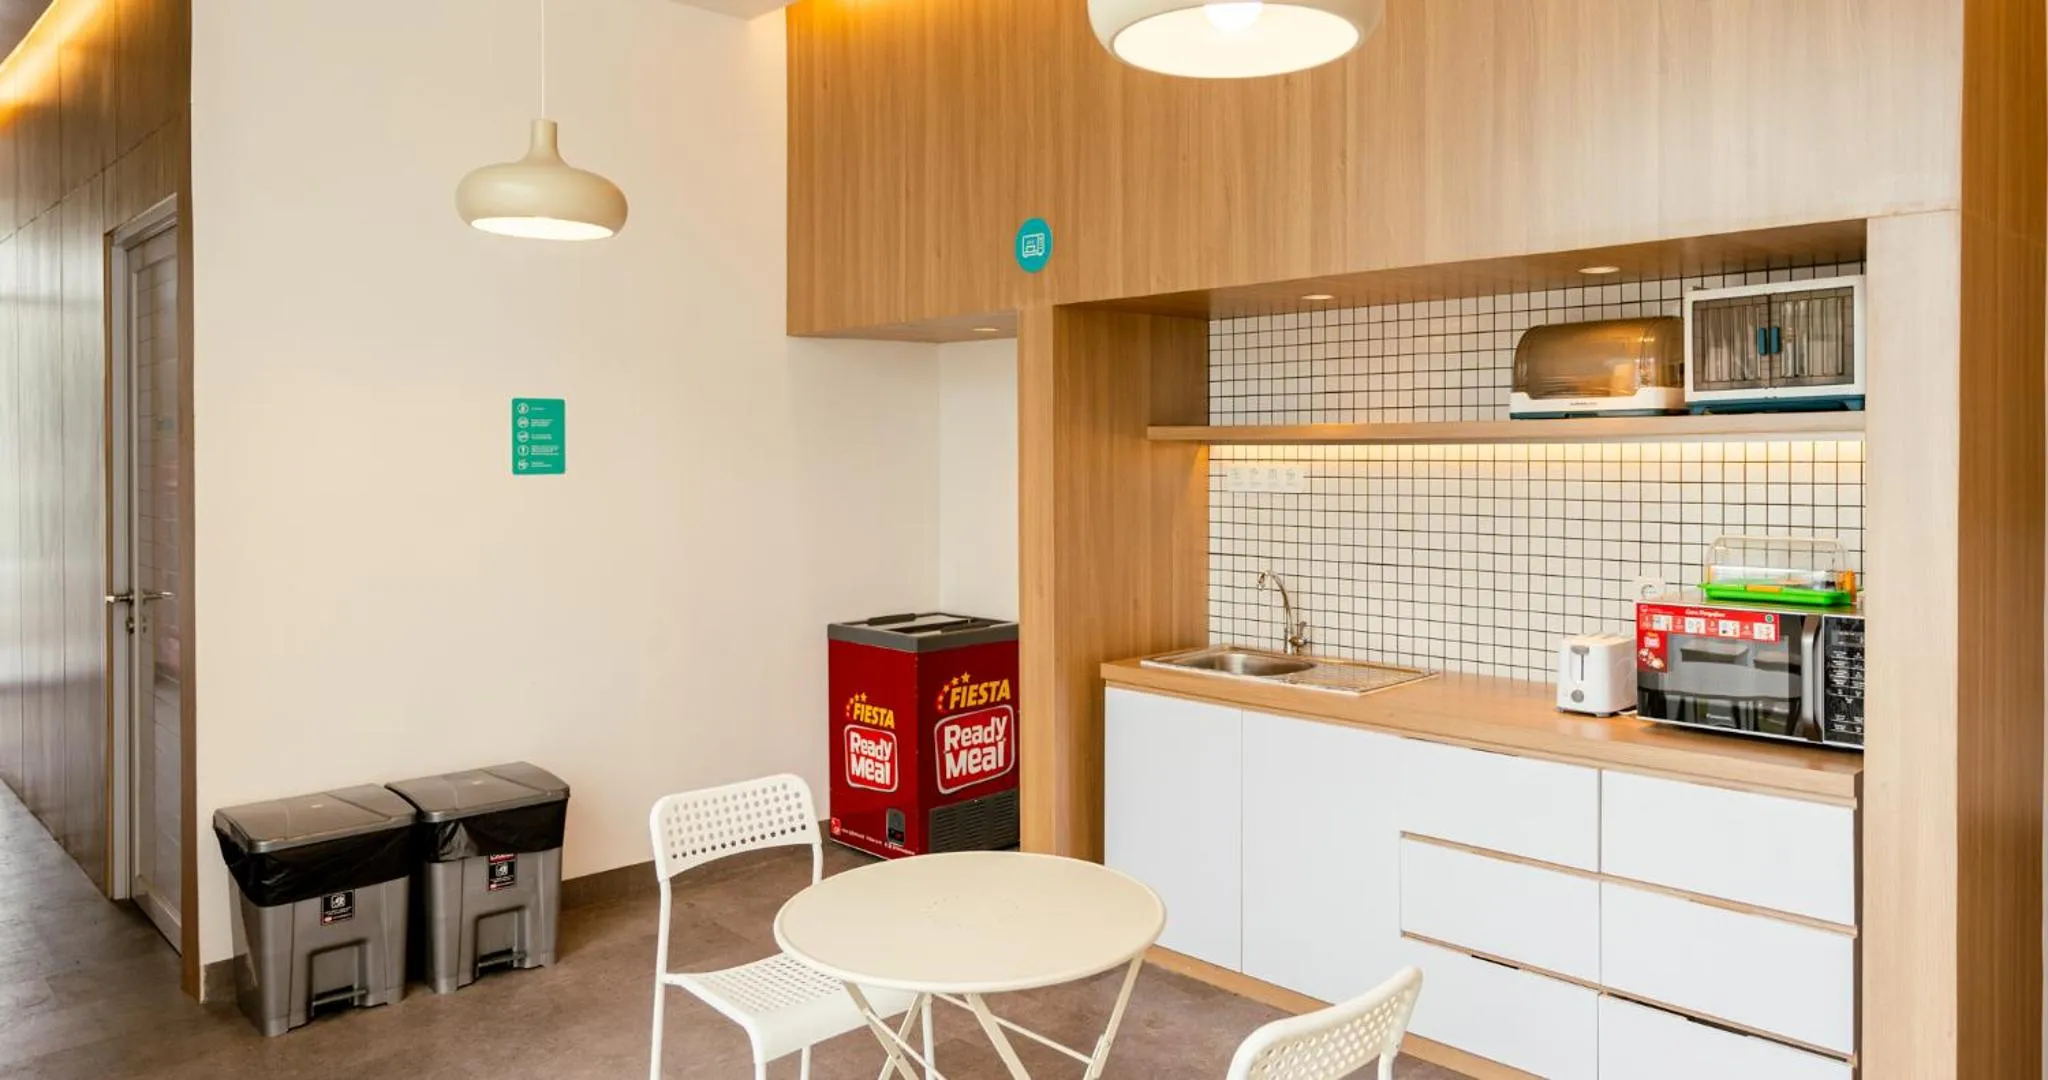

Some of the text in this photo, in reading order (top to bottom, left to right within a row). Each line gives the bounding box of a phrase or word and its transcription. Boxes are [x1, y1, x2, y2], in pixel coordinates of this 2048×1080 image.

[949, 678, 1011, 710] FIESTA
[853, 702, 895, 729] FIESTA
[849, 730, 893, 761] Ready
[944, 715, 1008, 752] Ready
[850, 753, 891, 785] Meal
[944, 738, 1006, 780] Meal
